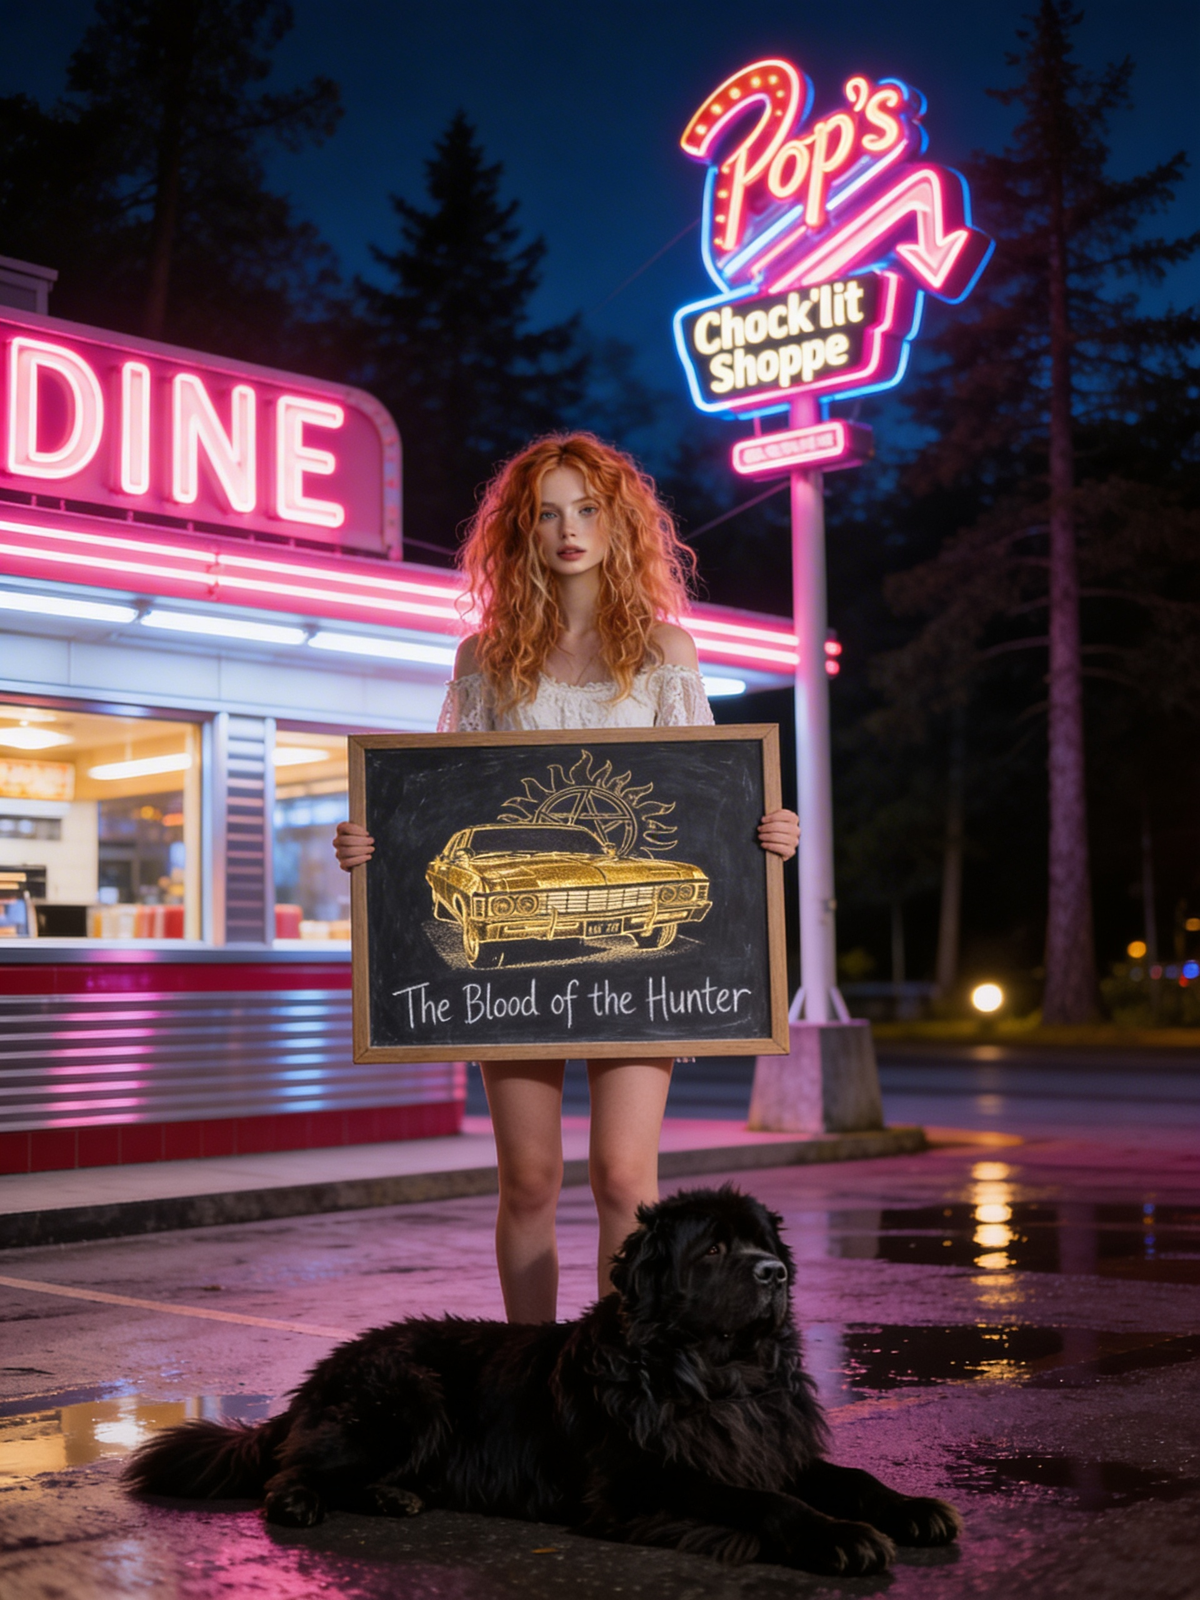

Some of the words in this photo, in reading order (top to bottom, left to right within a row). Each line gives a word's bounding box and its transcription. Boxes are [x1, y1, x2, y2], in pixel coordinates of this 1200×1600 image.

[681, 59, 903, 250] Pop's
[693, 281, 864, 355] Chock'lit
[709, 333, 850, 394] Shoppe
[7, 336, 345, 528] DINE
[393, 982, 452, 1028] The
[463, 979, 539, 1025] Blood
[550, 979, 579, 1028] of
[588, 980, 637, 1015] the
[646, 976, 751, 1021] Hunter
